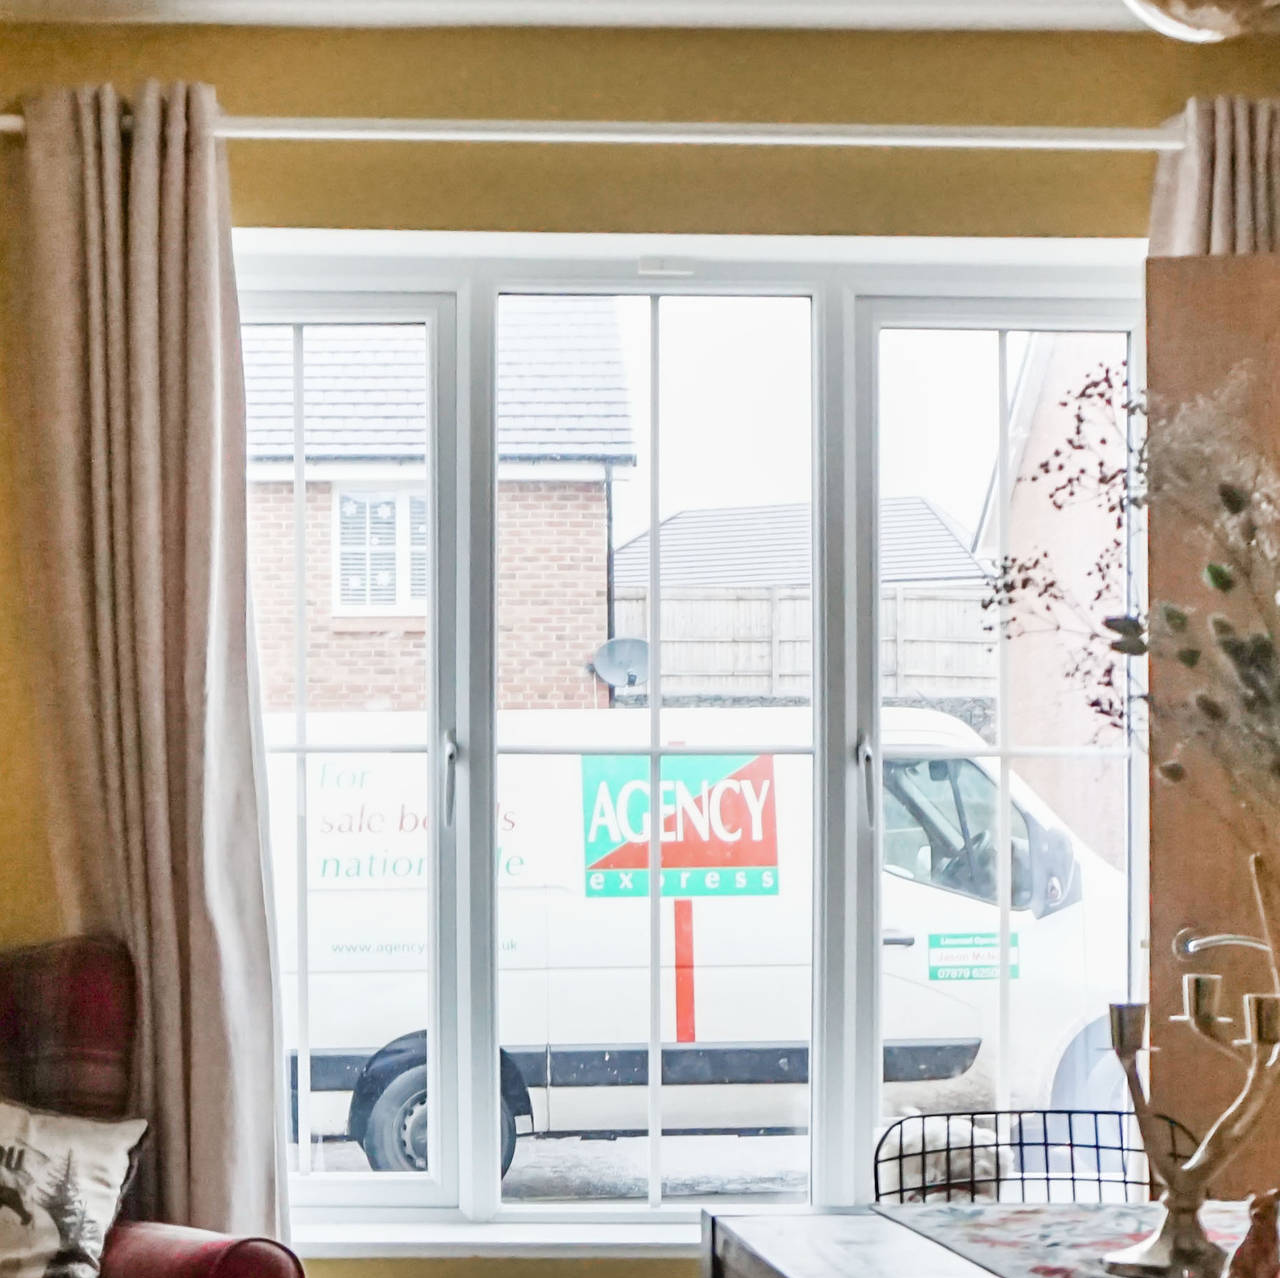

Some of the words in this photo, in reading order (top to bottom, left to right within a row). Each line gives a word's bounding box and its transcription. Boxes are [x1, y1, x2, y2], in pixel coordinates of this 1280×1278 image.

[320, 802, 385, 833] sale
[588, 779, 770, 844] AGENCY
[589, 870, 774, 891] exress
